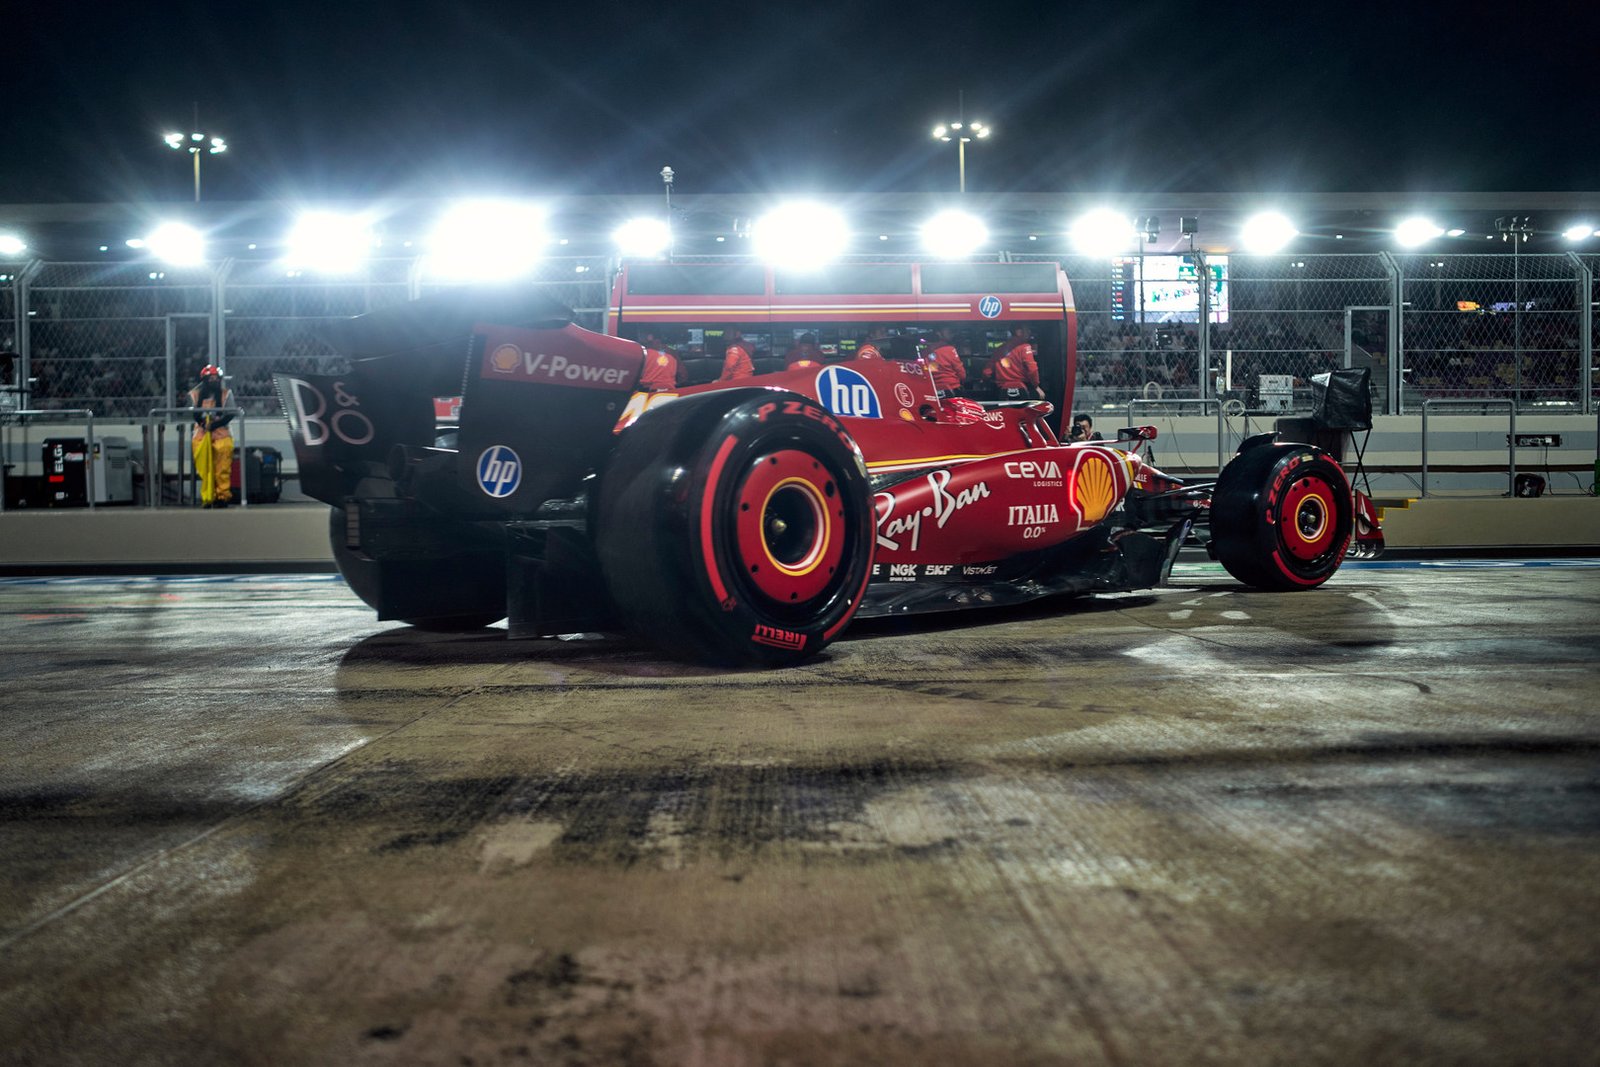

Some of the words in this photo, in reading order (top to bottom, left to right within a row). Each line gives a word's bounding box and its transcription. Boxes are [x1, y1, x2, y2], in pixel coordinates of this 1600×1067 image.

[982, 296, 999, 318] hp
[524, 352, 630, 385] V-Power
[829, 365, 871, 417] hp
[983, 412, 1004, 422] aws
[481, 446, 516, 497] hp
[1008, 503, 1060, 526] ITALIA
[890, 564, 917, 576] NGK
[925, 565, 954, 576] SKF
[751, 623, 807, 650] PIRELLI
